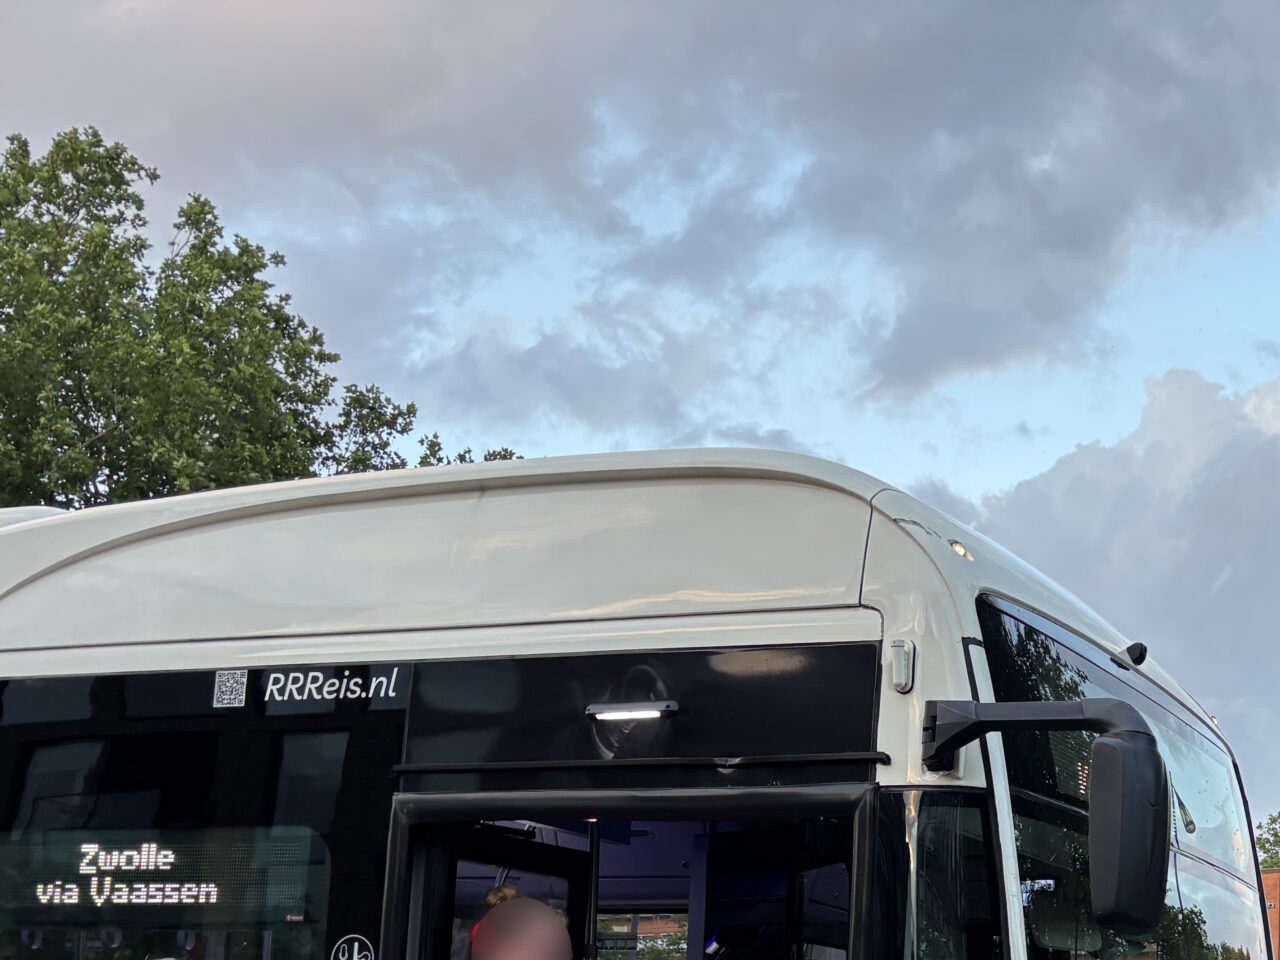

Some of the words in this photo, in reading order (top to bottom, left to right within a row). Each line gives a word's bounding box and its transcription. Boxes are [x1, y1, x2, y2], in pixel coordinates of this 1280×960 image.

[264, 667, 398, 701] RRReis.nl
[79, 843, 175, 874] Zwolle
[36, 881, 79, 904] via
[90, 877, 218, 907] Vaassen
